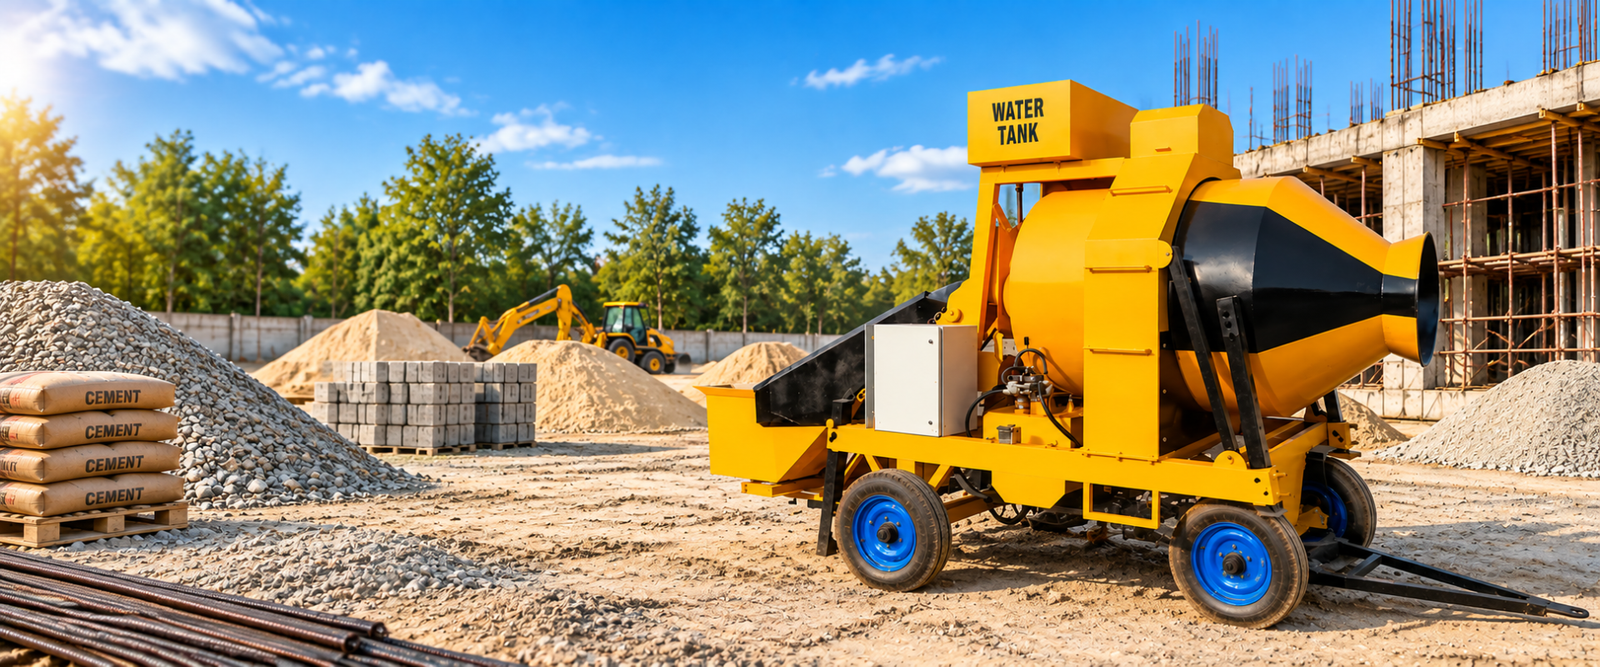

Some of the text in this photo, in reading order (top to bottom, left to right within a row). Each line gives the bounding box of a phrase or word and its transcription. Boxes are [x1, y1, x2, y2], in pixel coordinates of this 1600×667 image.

[992, 97, 1044, 122] WATER
[997, 122, 1039, 145] TANK
[85, 390, 141, 405] CEMENT
[85, 423, 142, 439] CEMENT
[85, 455, 144, 473] CEMENT
[85, 487, 144, 506] CEMENT
